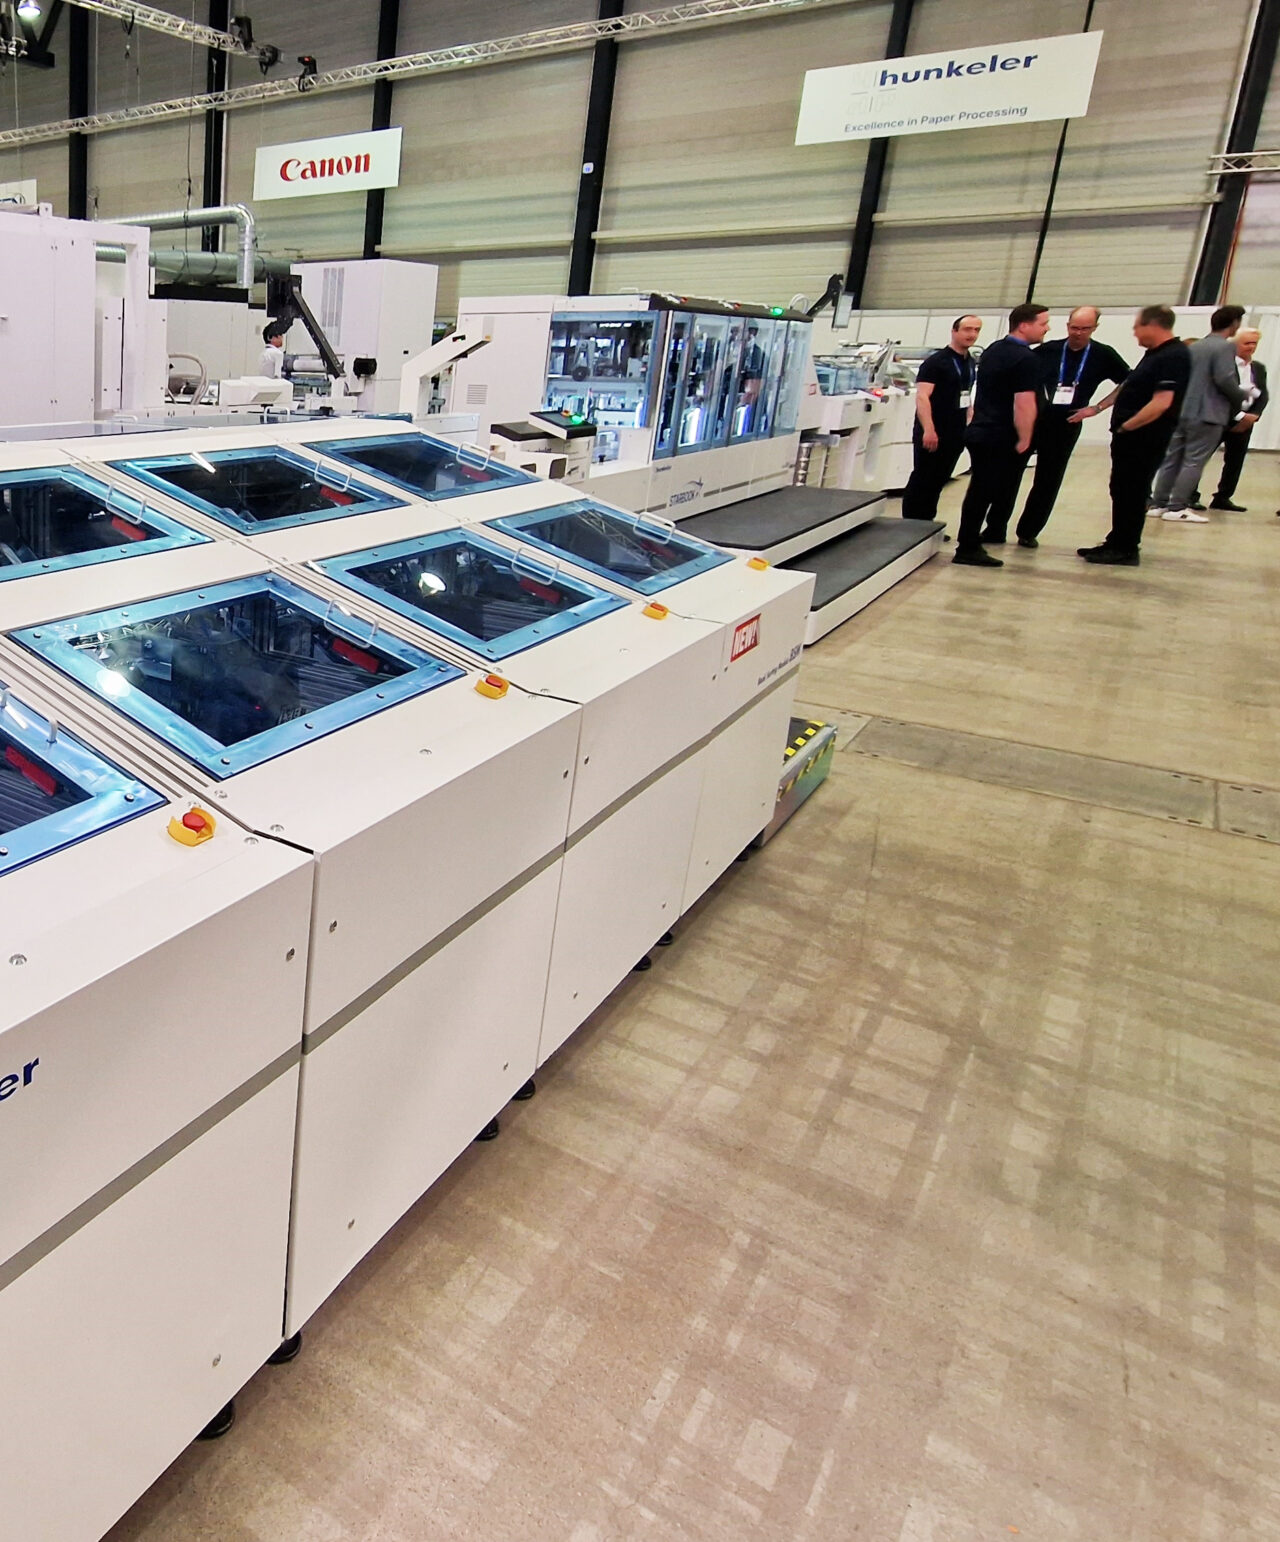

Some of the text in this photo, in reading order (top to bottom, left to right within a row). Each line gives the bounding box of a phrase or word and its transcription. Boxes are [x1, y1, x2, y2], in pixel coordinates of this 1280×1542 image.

[878, 54, 1039, 87] hunkeler
[844, 105, 1029, 134] Excellence in Paper Processing
[279, 152, 371, 183] Canon
